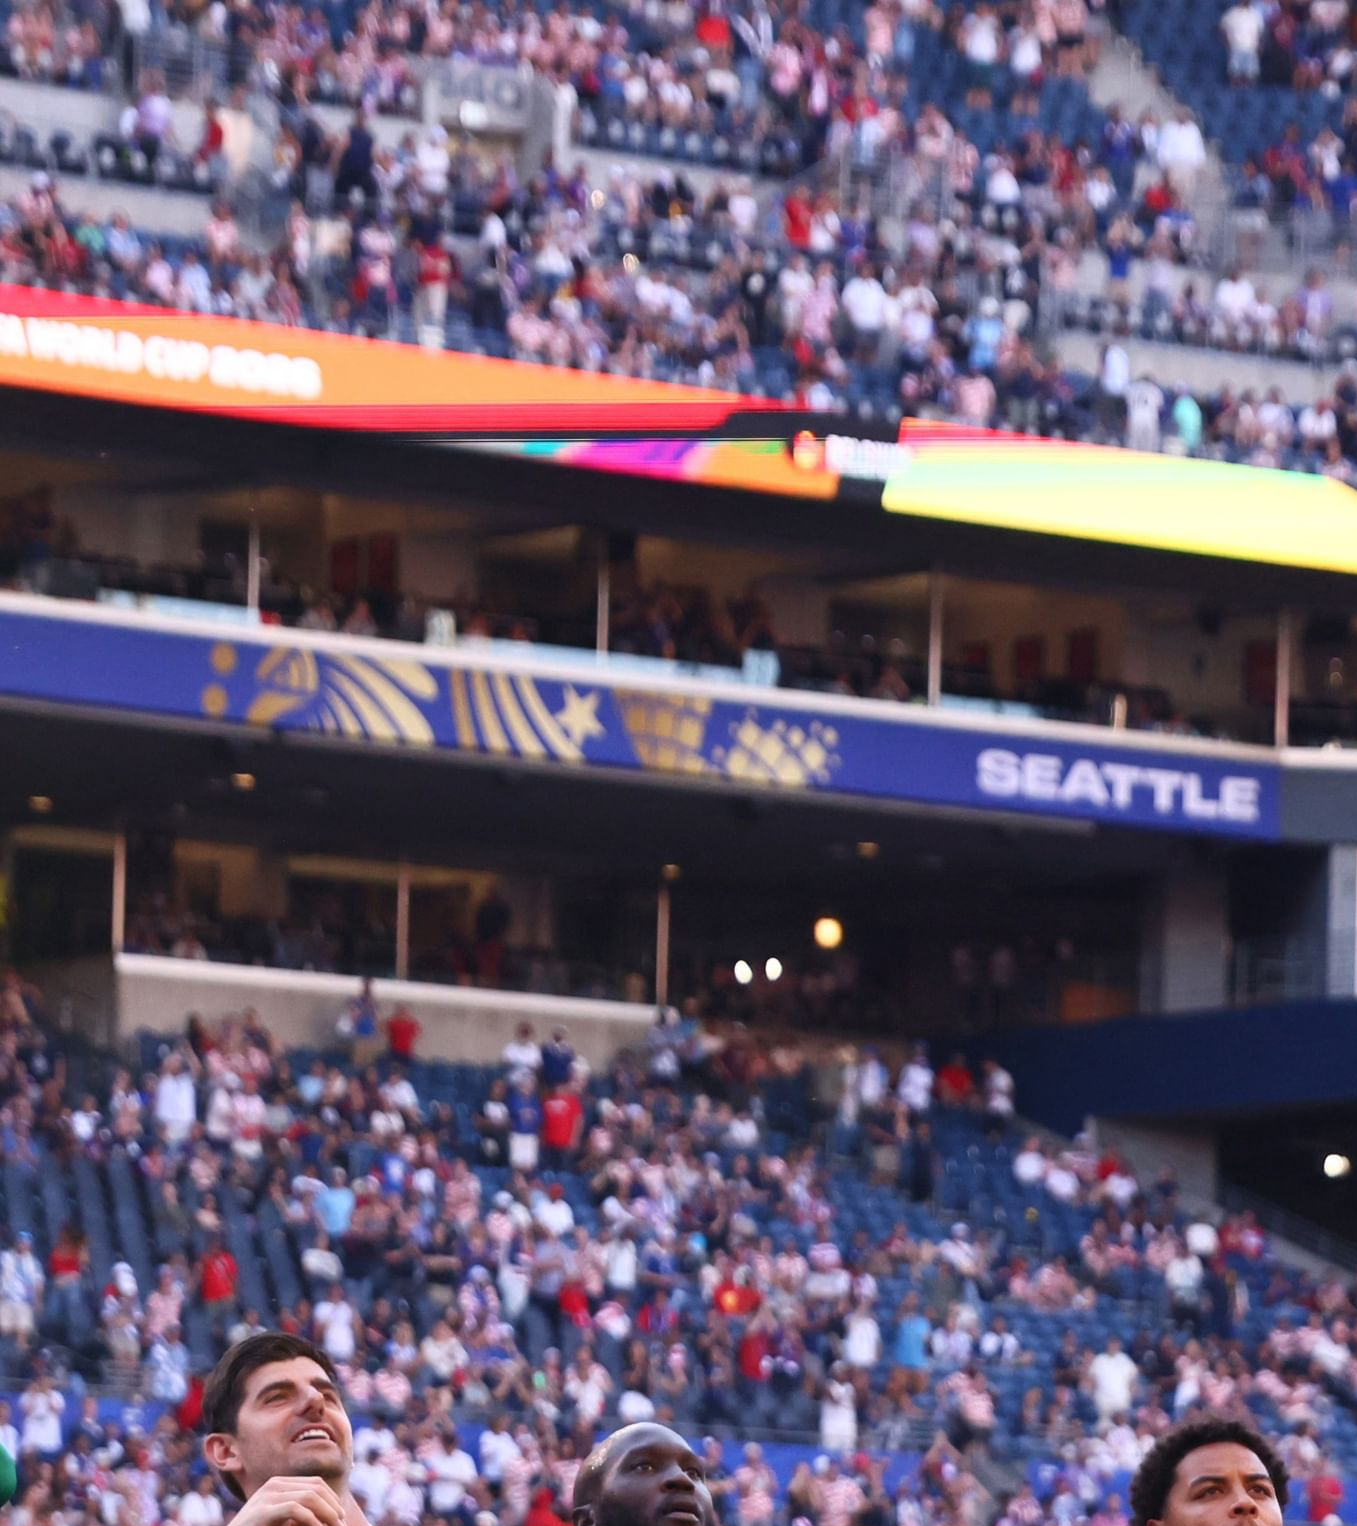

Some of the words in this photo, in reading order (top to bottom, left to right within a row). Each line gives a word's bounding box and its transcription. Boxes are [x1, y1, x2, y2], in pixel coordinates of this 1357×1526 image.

[26, 316, 144, 374] WORLD
[144, 335, 210, 382] CUP
[977, 748, 1260, 824] SEATTLE
